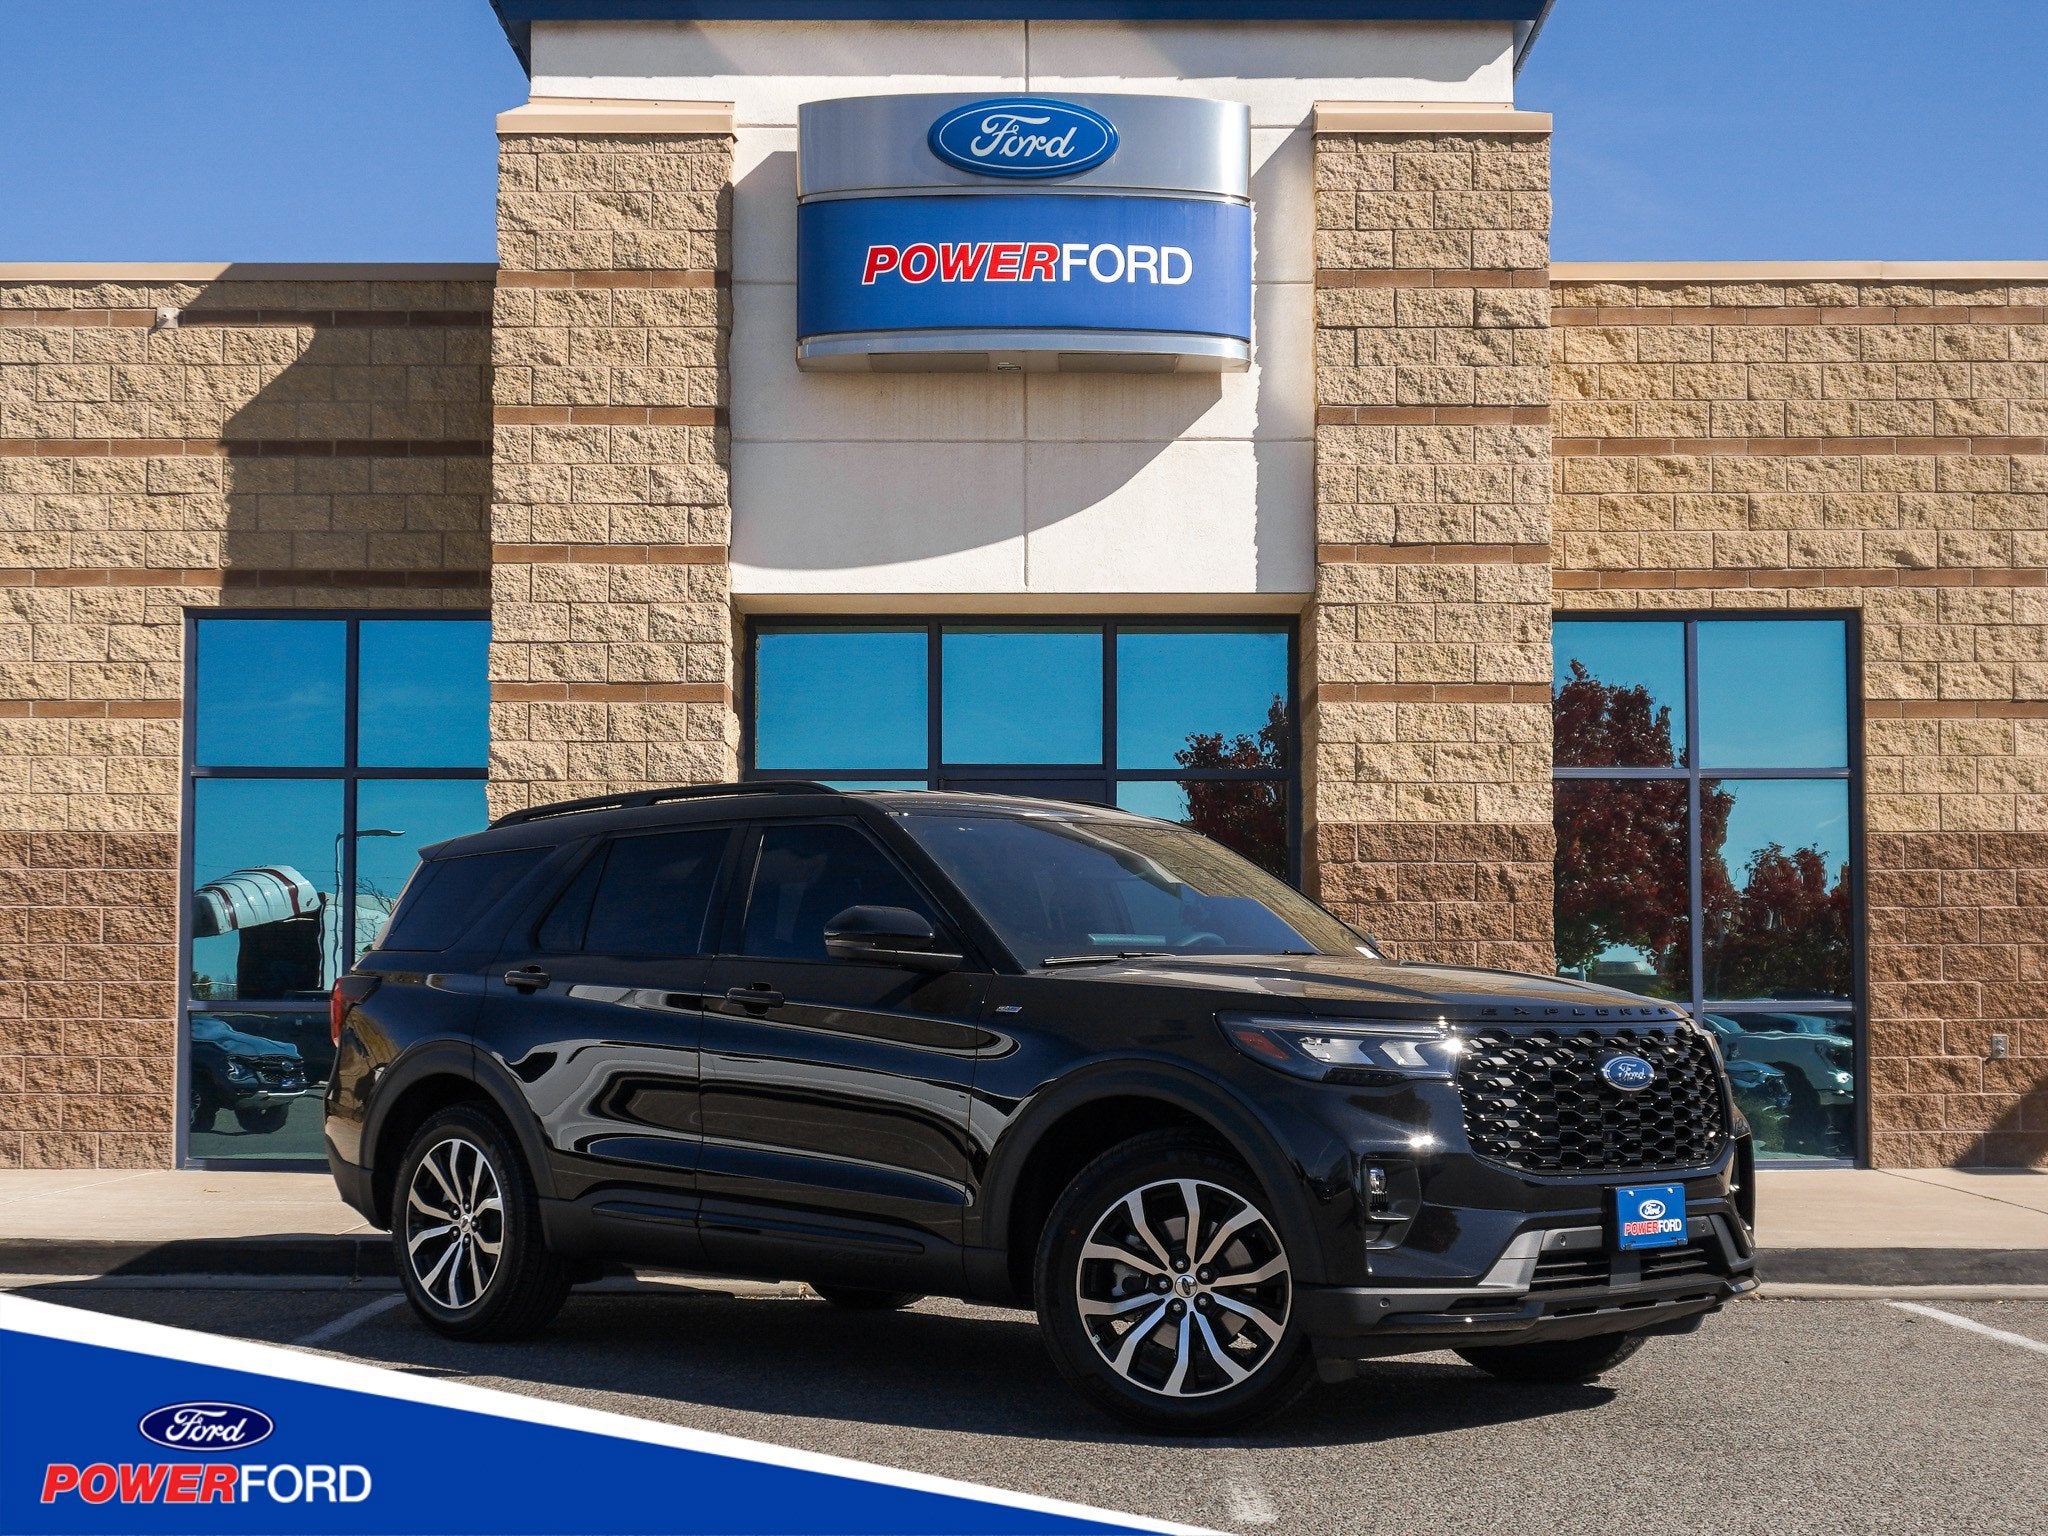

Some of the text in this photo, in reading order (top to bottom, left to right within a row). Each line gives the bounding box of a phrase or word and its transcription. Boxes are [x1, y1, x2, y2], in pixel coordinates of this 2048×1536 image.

[970, 113, 1076, 159] Ford
[1481, 1006, 1671, 1017] EXPLORER
[1618, 1063, 1645, 1080] Ford
[1645, 1203, 1660, 1215] Ford
